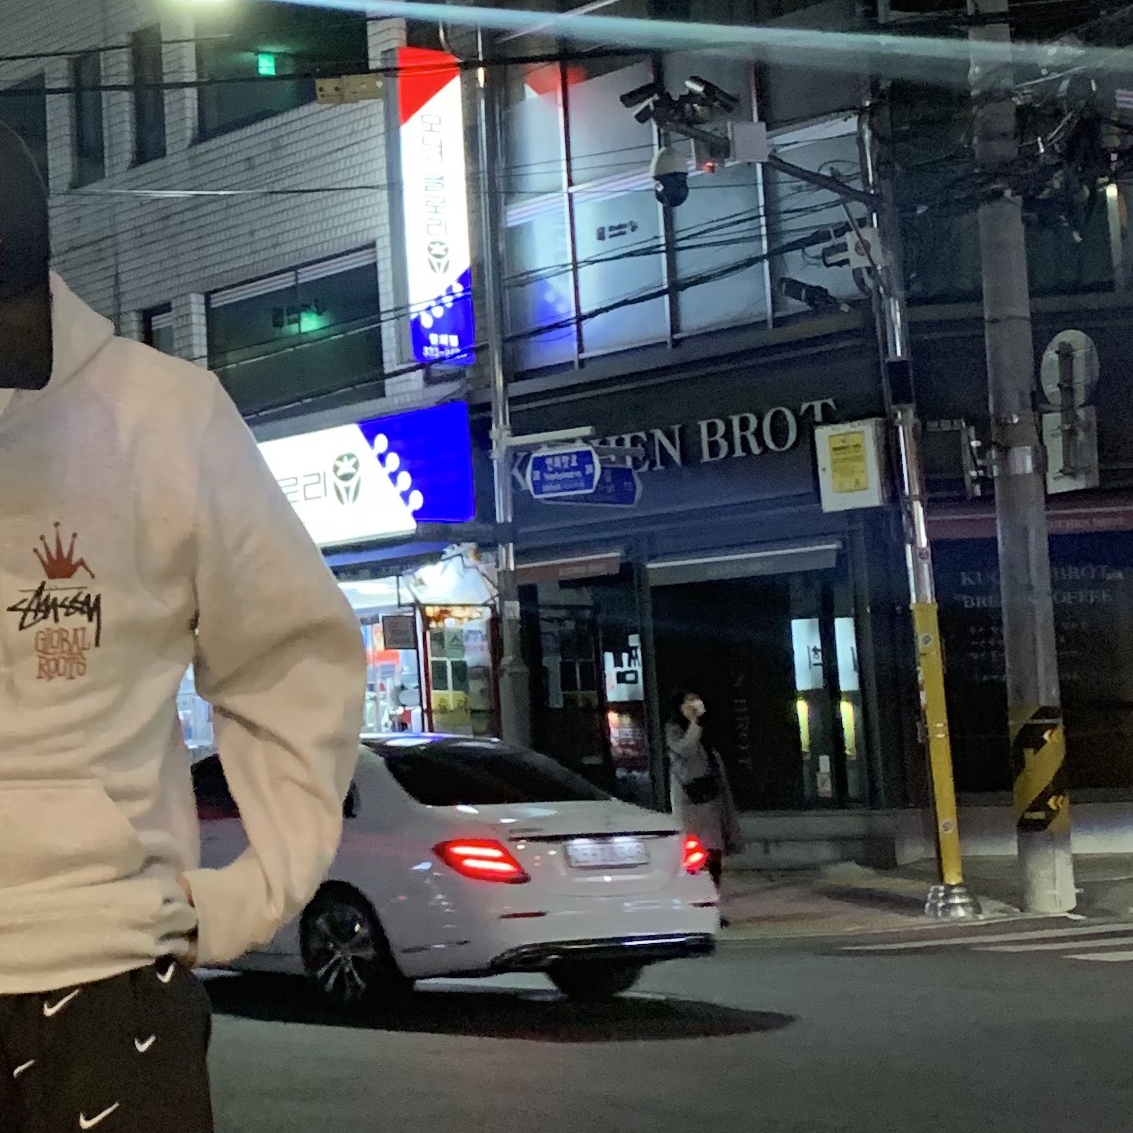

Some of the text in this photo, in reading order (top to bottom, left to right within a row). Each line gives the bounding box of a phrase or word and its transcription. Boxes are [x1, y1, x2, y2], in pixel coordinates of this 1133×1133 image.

[697, 398, 837, 463] BROT
[34, 627, 90, 656] GLOBAL
[36, 652, 87, 681] ROOTS
